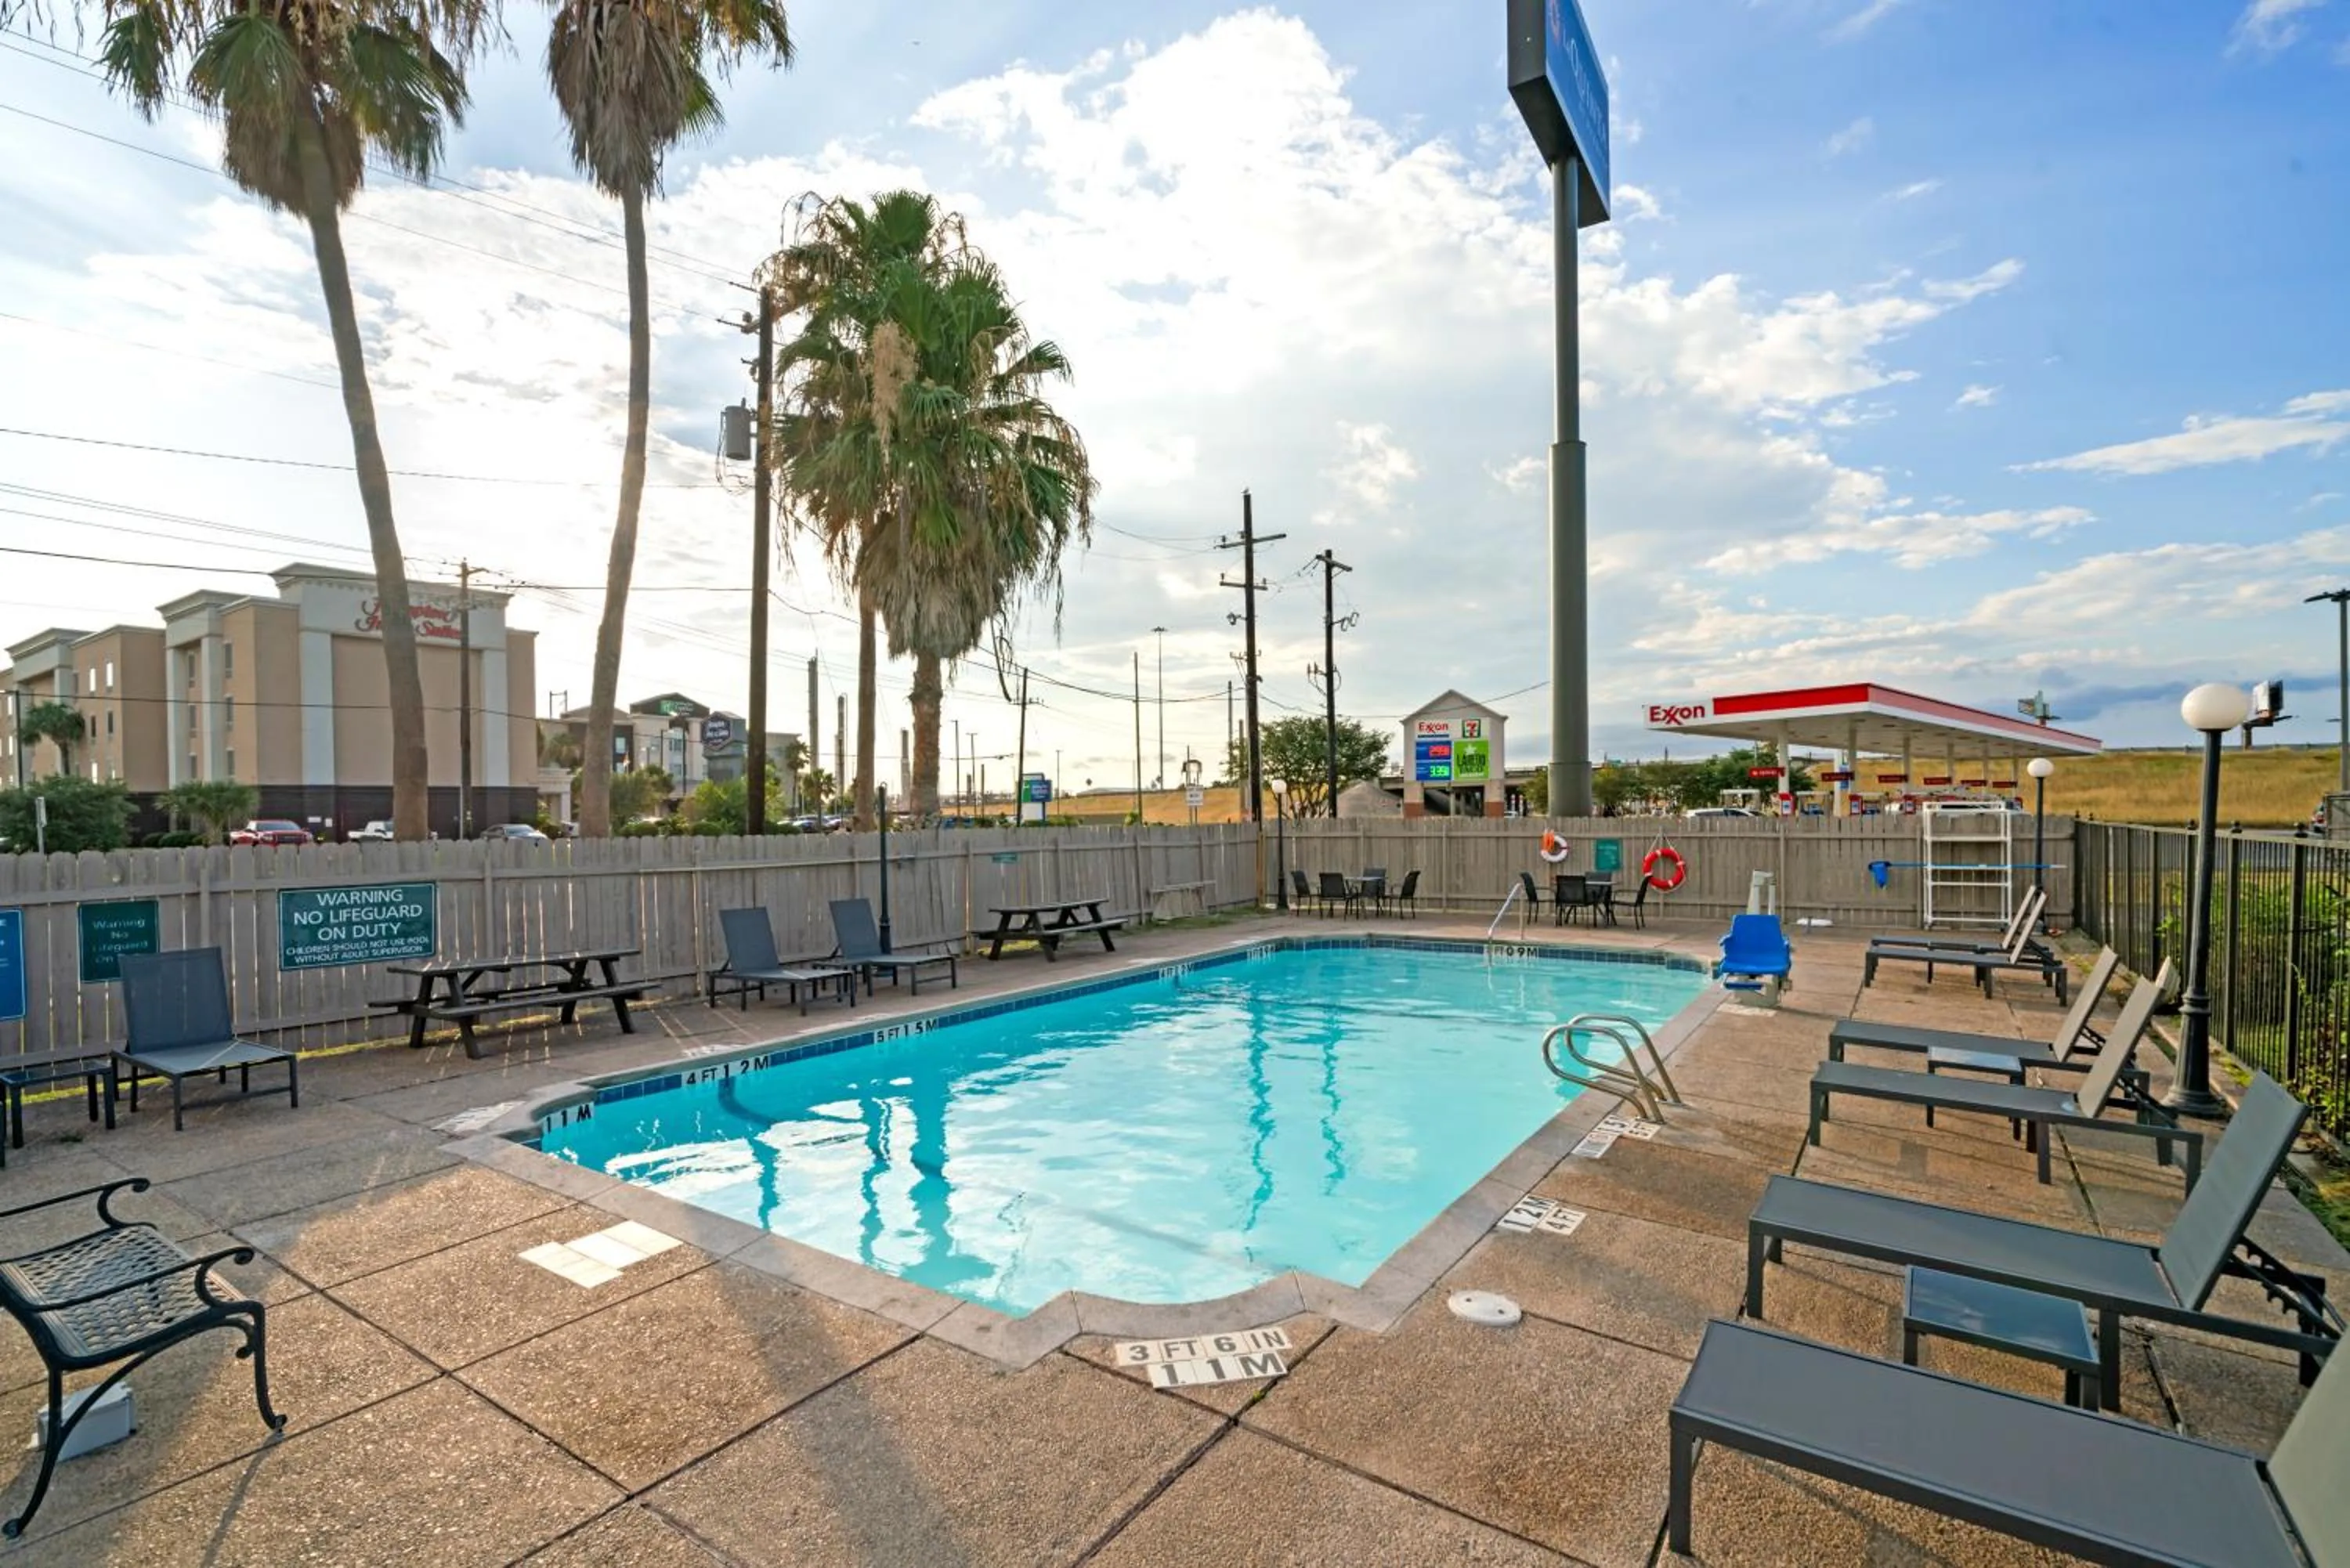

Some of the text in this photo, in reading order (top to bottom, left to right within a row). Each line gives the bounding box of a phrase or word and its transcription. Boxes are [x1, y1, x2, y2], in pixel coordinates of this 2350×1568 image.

[1650, 706, 1705, 725] Exxon
[1419, 721, 1448, 733] Exxon
[316, 889, 403, 906] WARNING
[294, 905, 423, 925] NO LIFEGUARD
[92, 919, 146, 929] Warning
[318, 922, 402, 941] ON DUTY
[295, 952, 339, 963] WITHOUT
